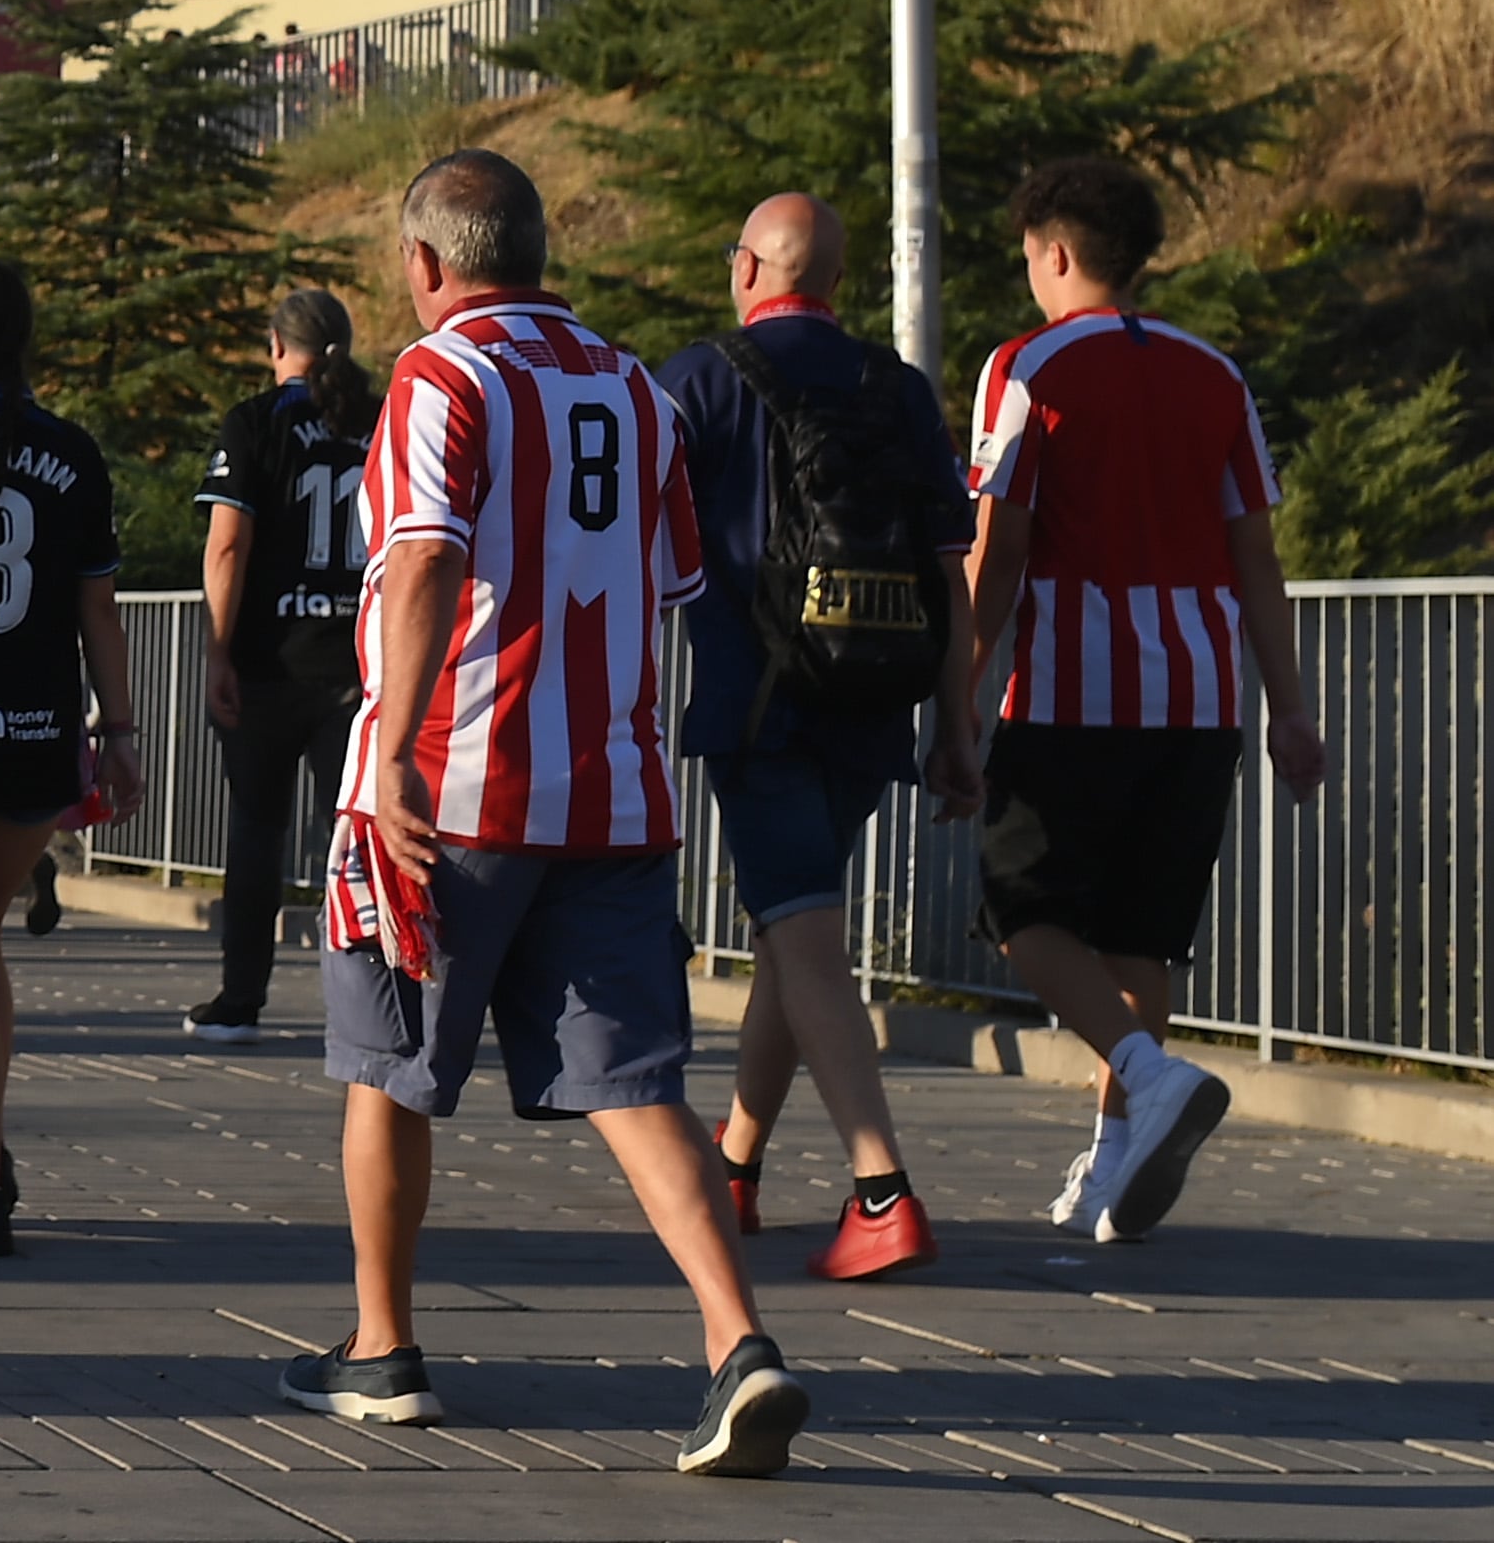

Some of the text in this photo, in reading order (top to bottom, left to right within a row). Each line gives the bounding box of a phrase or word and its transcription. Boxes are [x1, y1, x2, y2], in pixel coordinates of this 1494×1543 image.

[295, 463, 368, 570] 11
[568, 402, 619, 532] 8
[277, 583, 332, 618] ria
